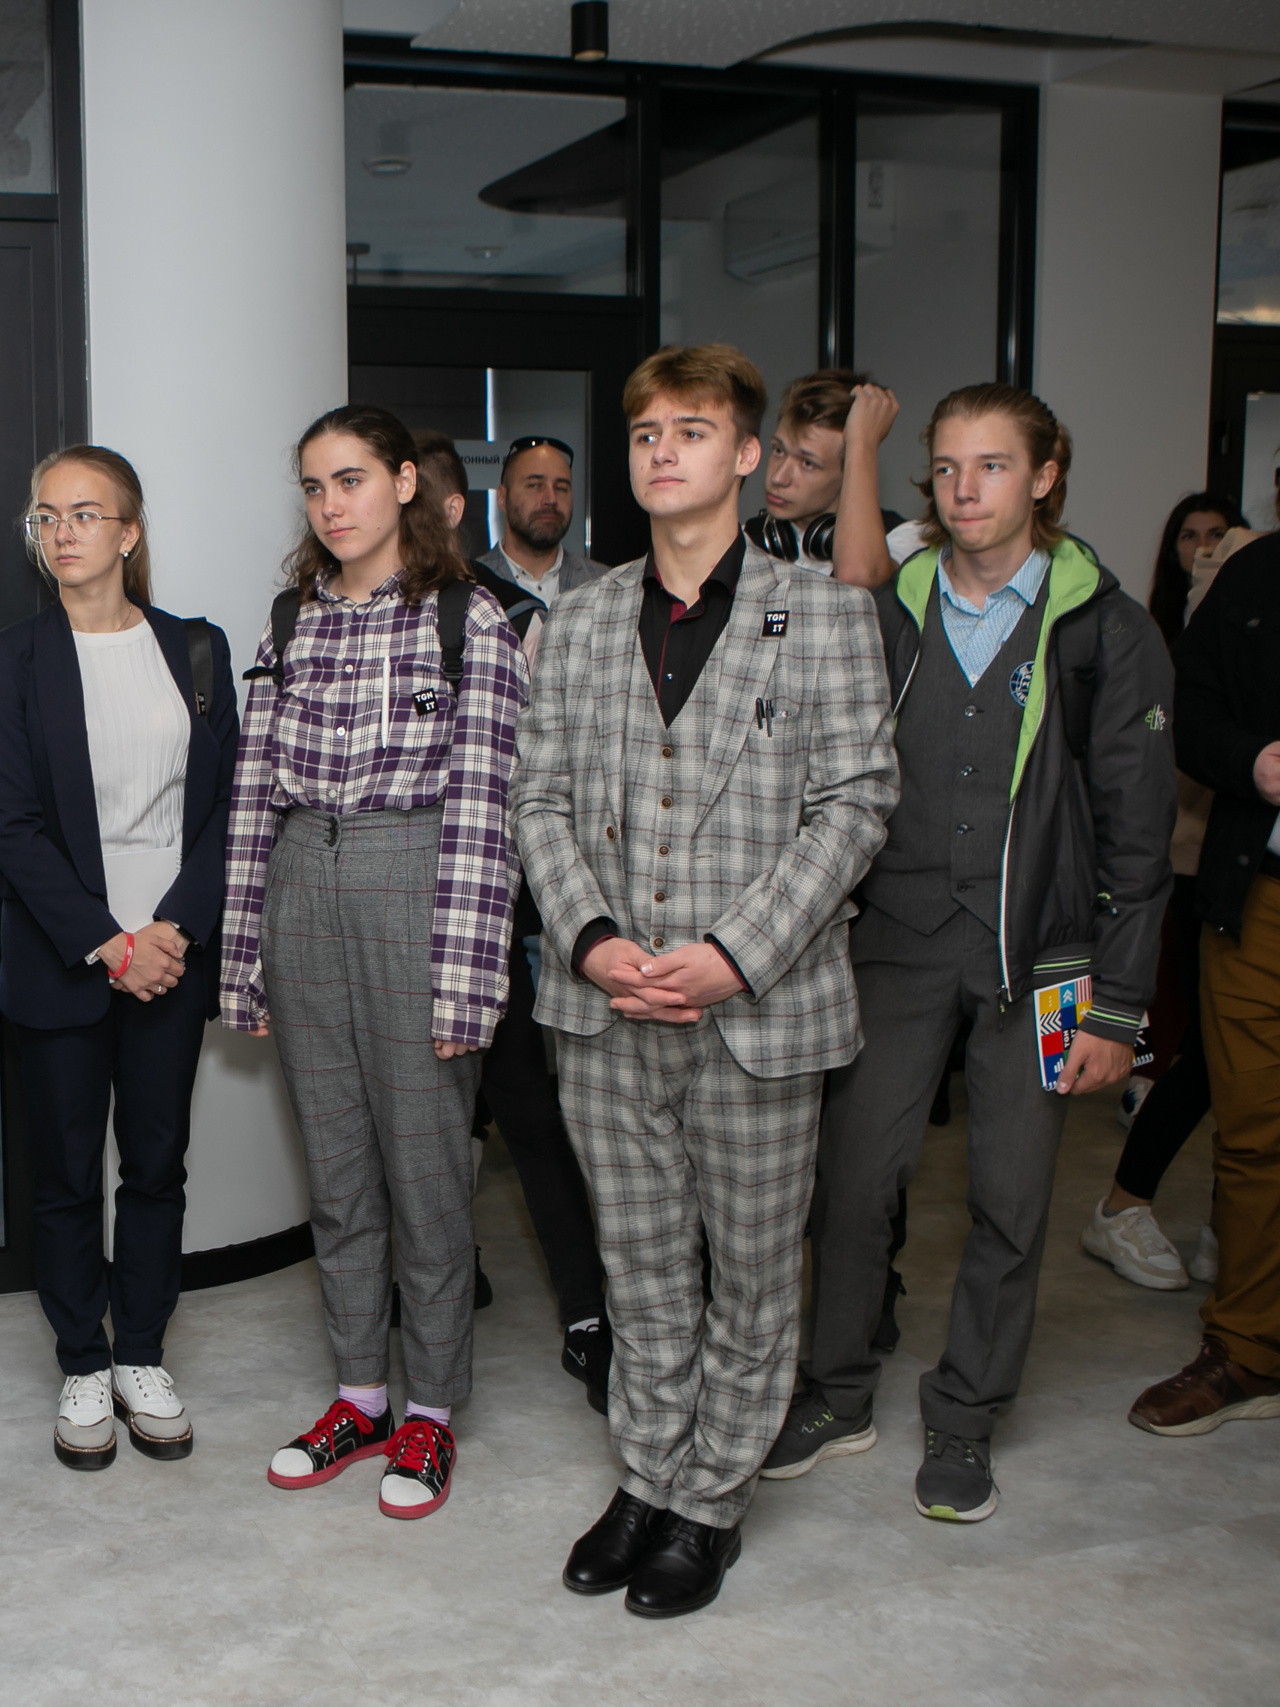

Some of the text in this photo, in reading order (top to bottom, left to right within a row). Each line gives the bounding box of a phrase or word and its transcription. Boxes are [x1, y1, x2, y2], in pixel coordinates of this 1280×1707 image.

[461, 454, 500, 465] ОННЫЙ
[773, 624, 784, 632] IT
[425, 701, 435, 710] IT
